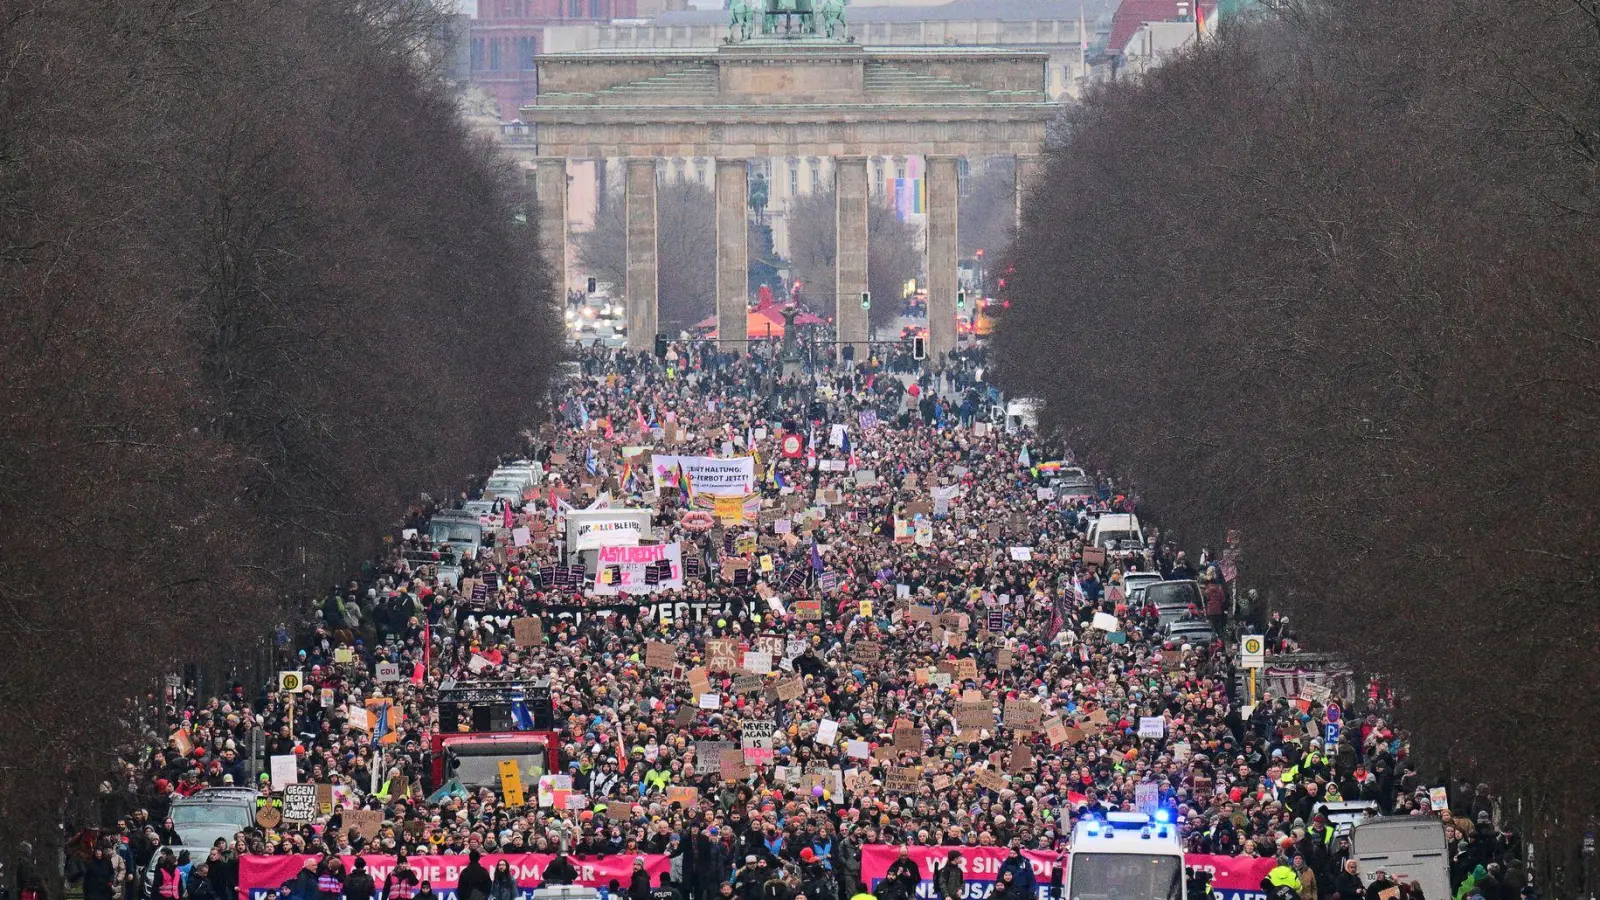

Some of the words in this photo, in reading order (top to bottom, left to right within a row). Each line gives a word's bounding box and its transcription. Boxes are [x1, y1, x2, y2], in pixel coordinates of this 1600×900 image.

[708, 641, 735, 657] FCK
[743, 722, 770, 730] NEVER
[753, 739, 762, 748] IS
[744, 748, 774, 759] NOW
[287, 785, 314, 795] GEGEN
[257, 798, 267, 807] NO
[286, 795, 316, 807] RECHTS!
